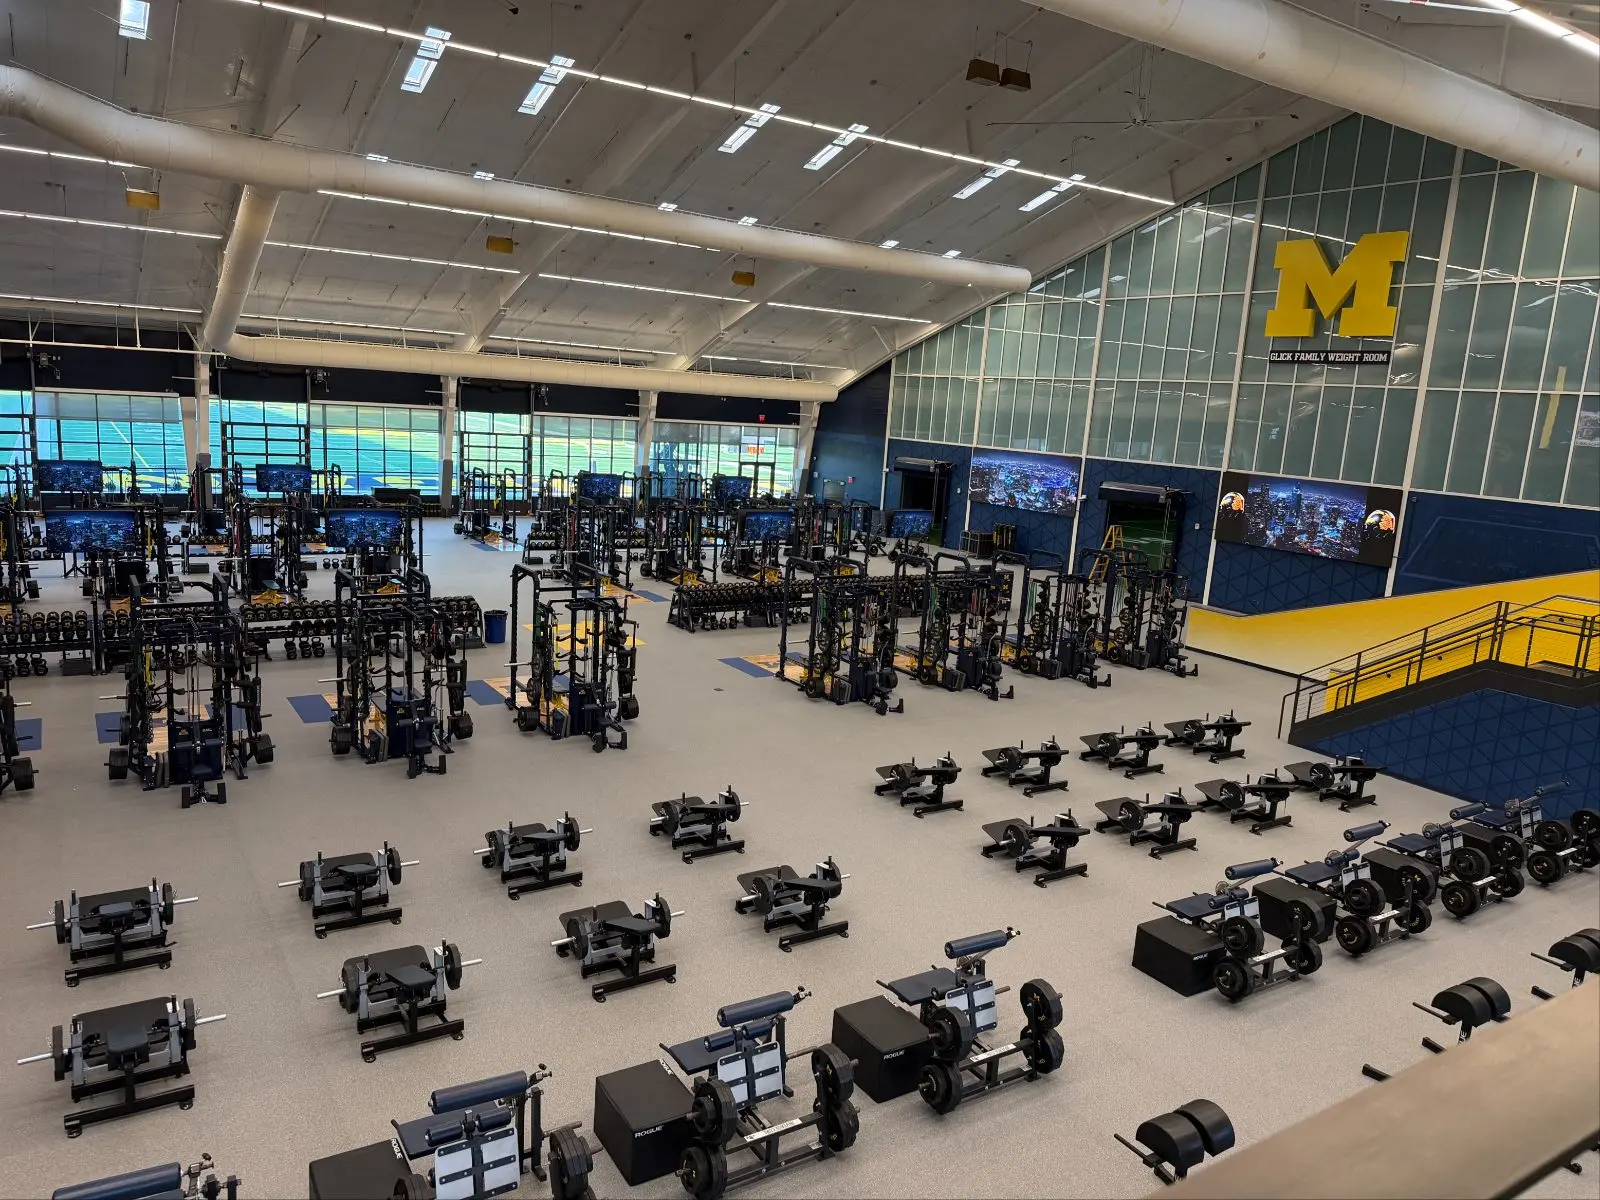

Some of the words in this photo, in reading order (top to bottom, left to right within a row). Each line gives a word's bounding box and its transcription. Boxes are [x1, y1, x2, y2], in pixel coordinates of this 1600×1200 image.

[1265, 231, 1409, 337] M
[1270, 352, 1292, 361] GLICK
[1294, 352, 1326, 362] FAMILY
[1328, 353, 1361, 362] WEIGHT
[1363, 353, 1388, 362] ROOM
[883, 1049, 905, 1060] ROGUE
[634, 1124, 665, 1139] ROGUE
[391, 1138, 404, 1160] ROGUE
